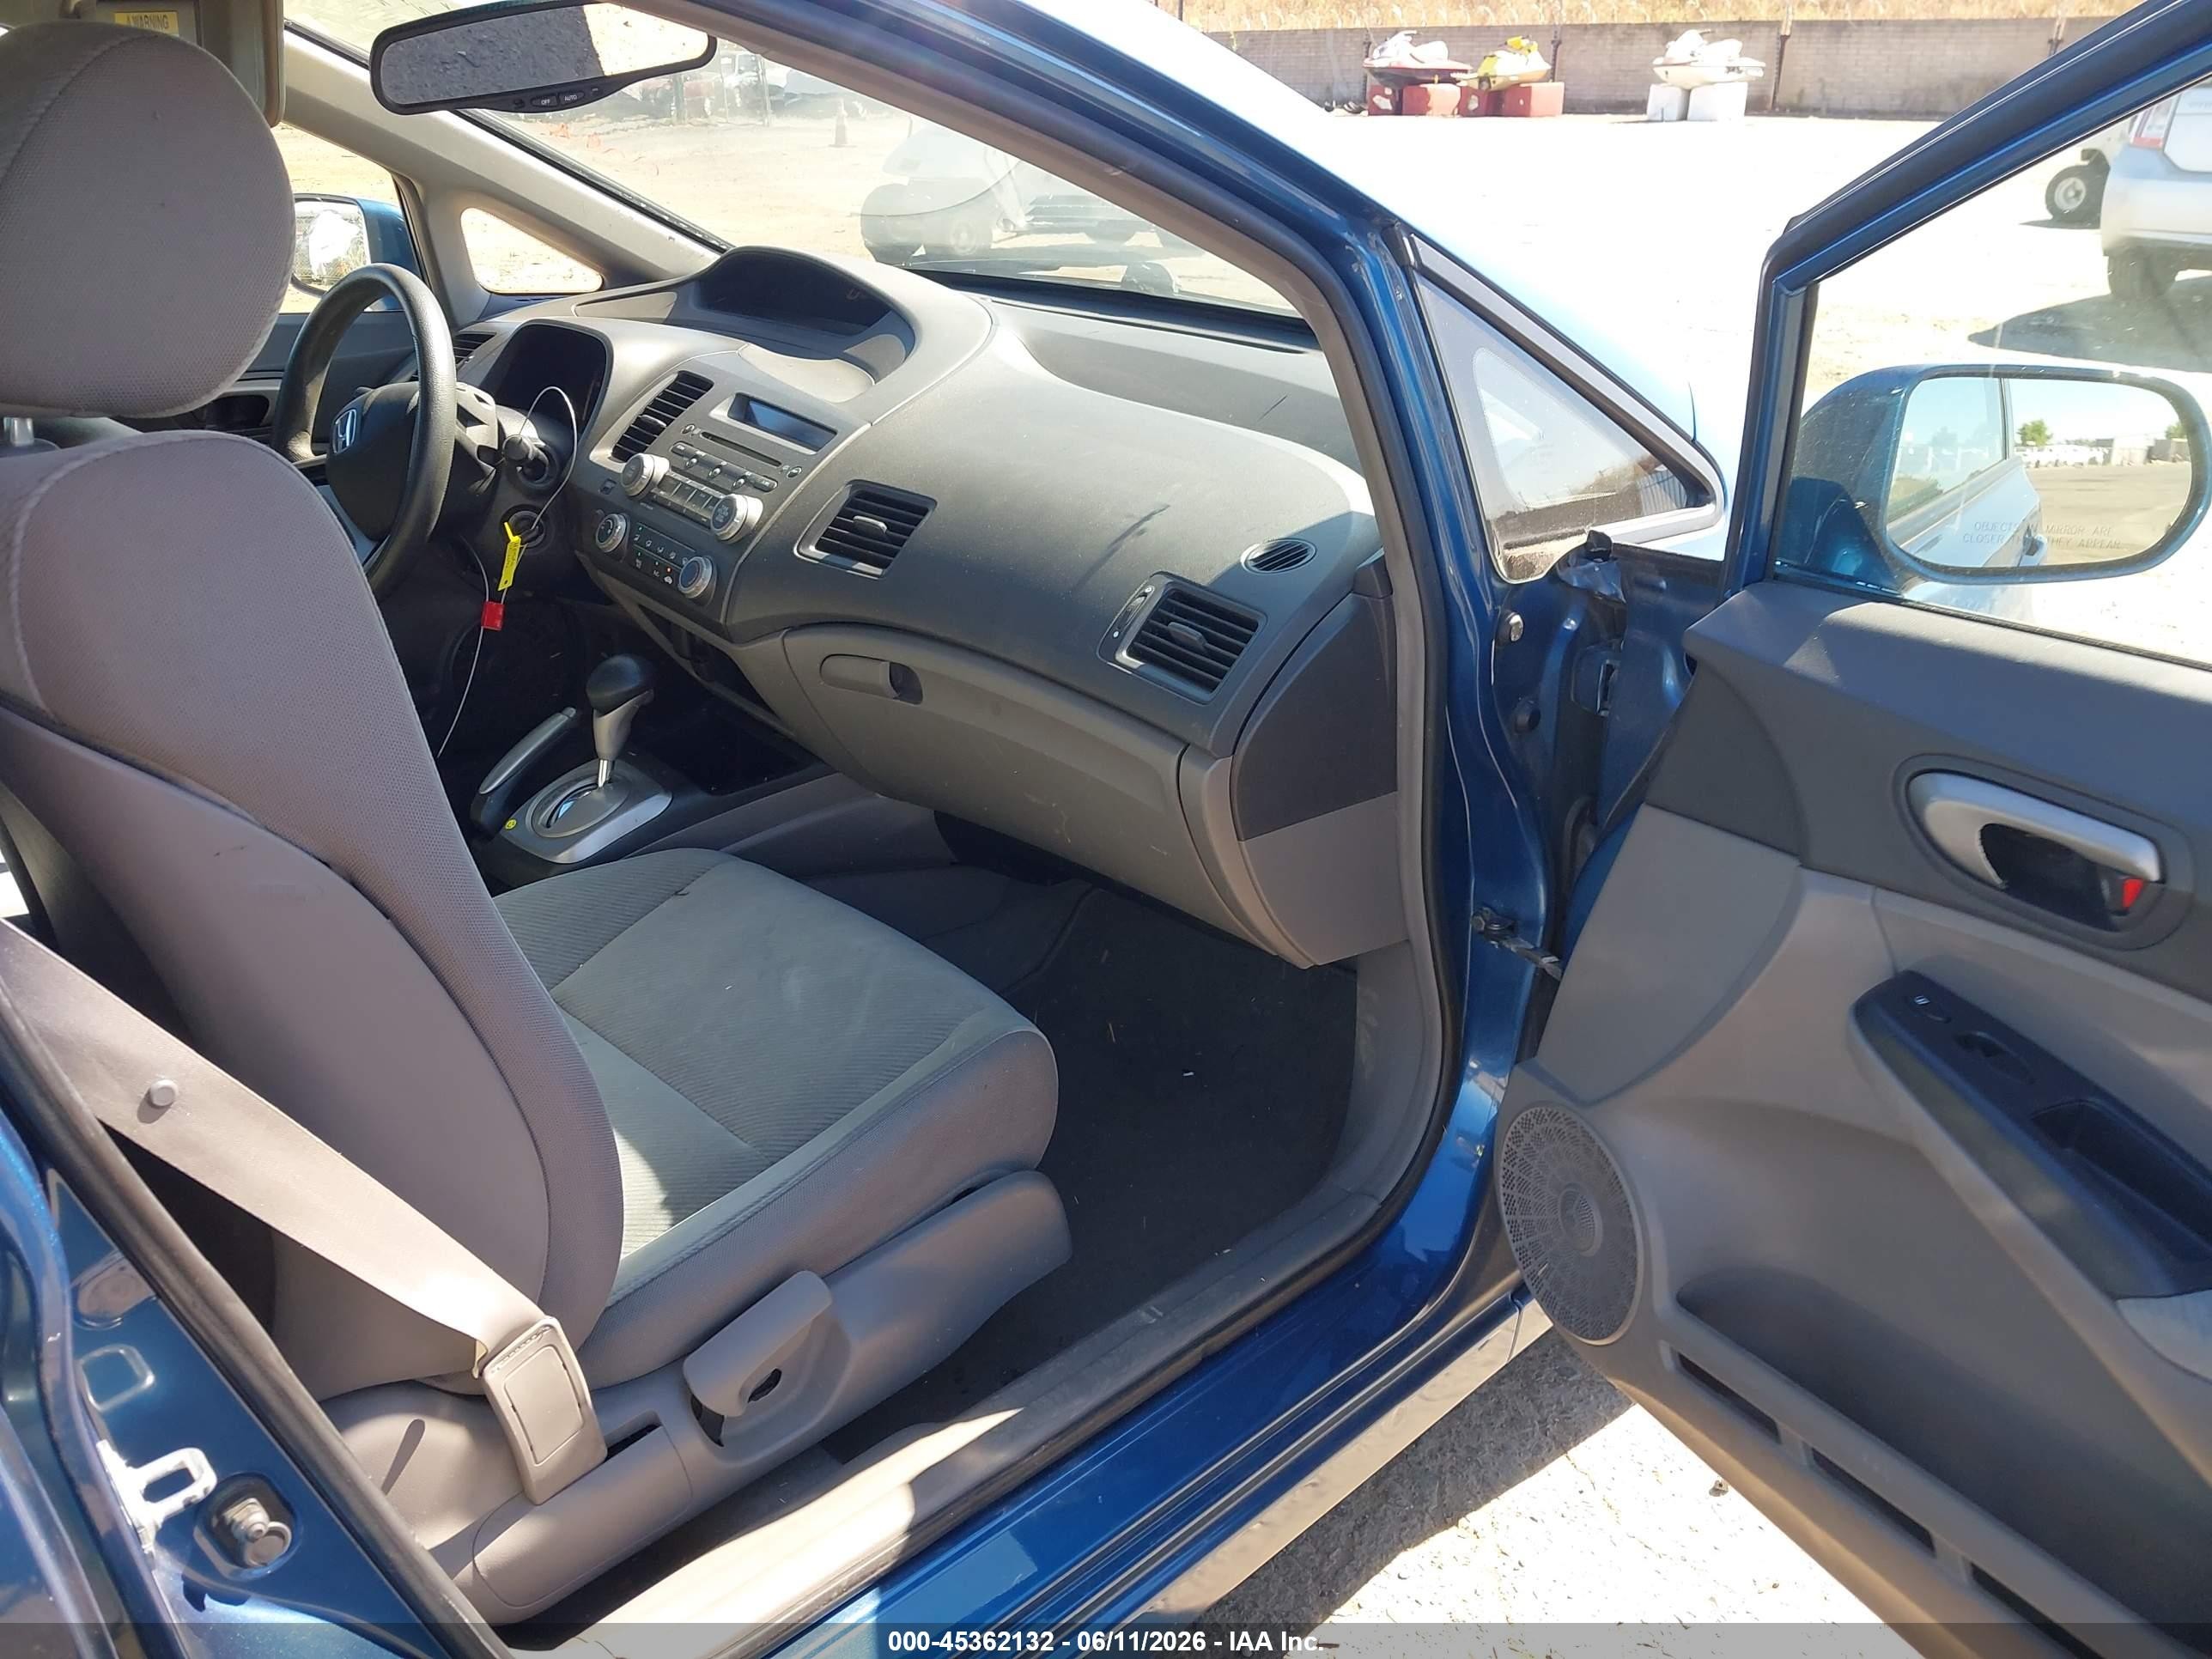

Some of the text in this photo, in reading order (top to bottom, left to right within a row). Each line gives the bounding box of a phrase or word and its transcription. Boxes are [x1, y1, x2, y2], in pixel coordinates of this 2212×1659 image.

[130, 13, 169, 29] WARNING
[2045, 524, 2086, 536] MIRROR
[2091, 526, 2113, 537] ARE
[1962, 533, 2005, 544] CLOSER
[2046, 536, 2074, 547] THEY
[2076, 538, 2122, 550] APPEAR
